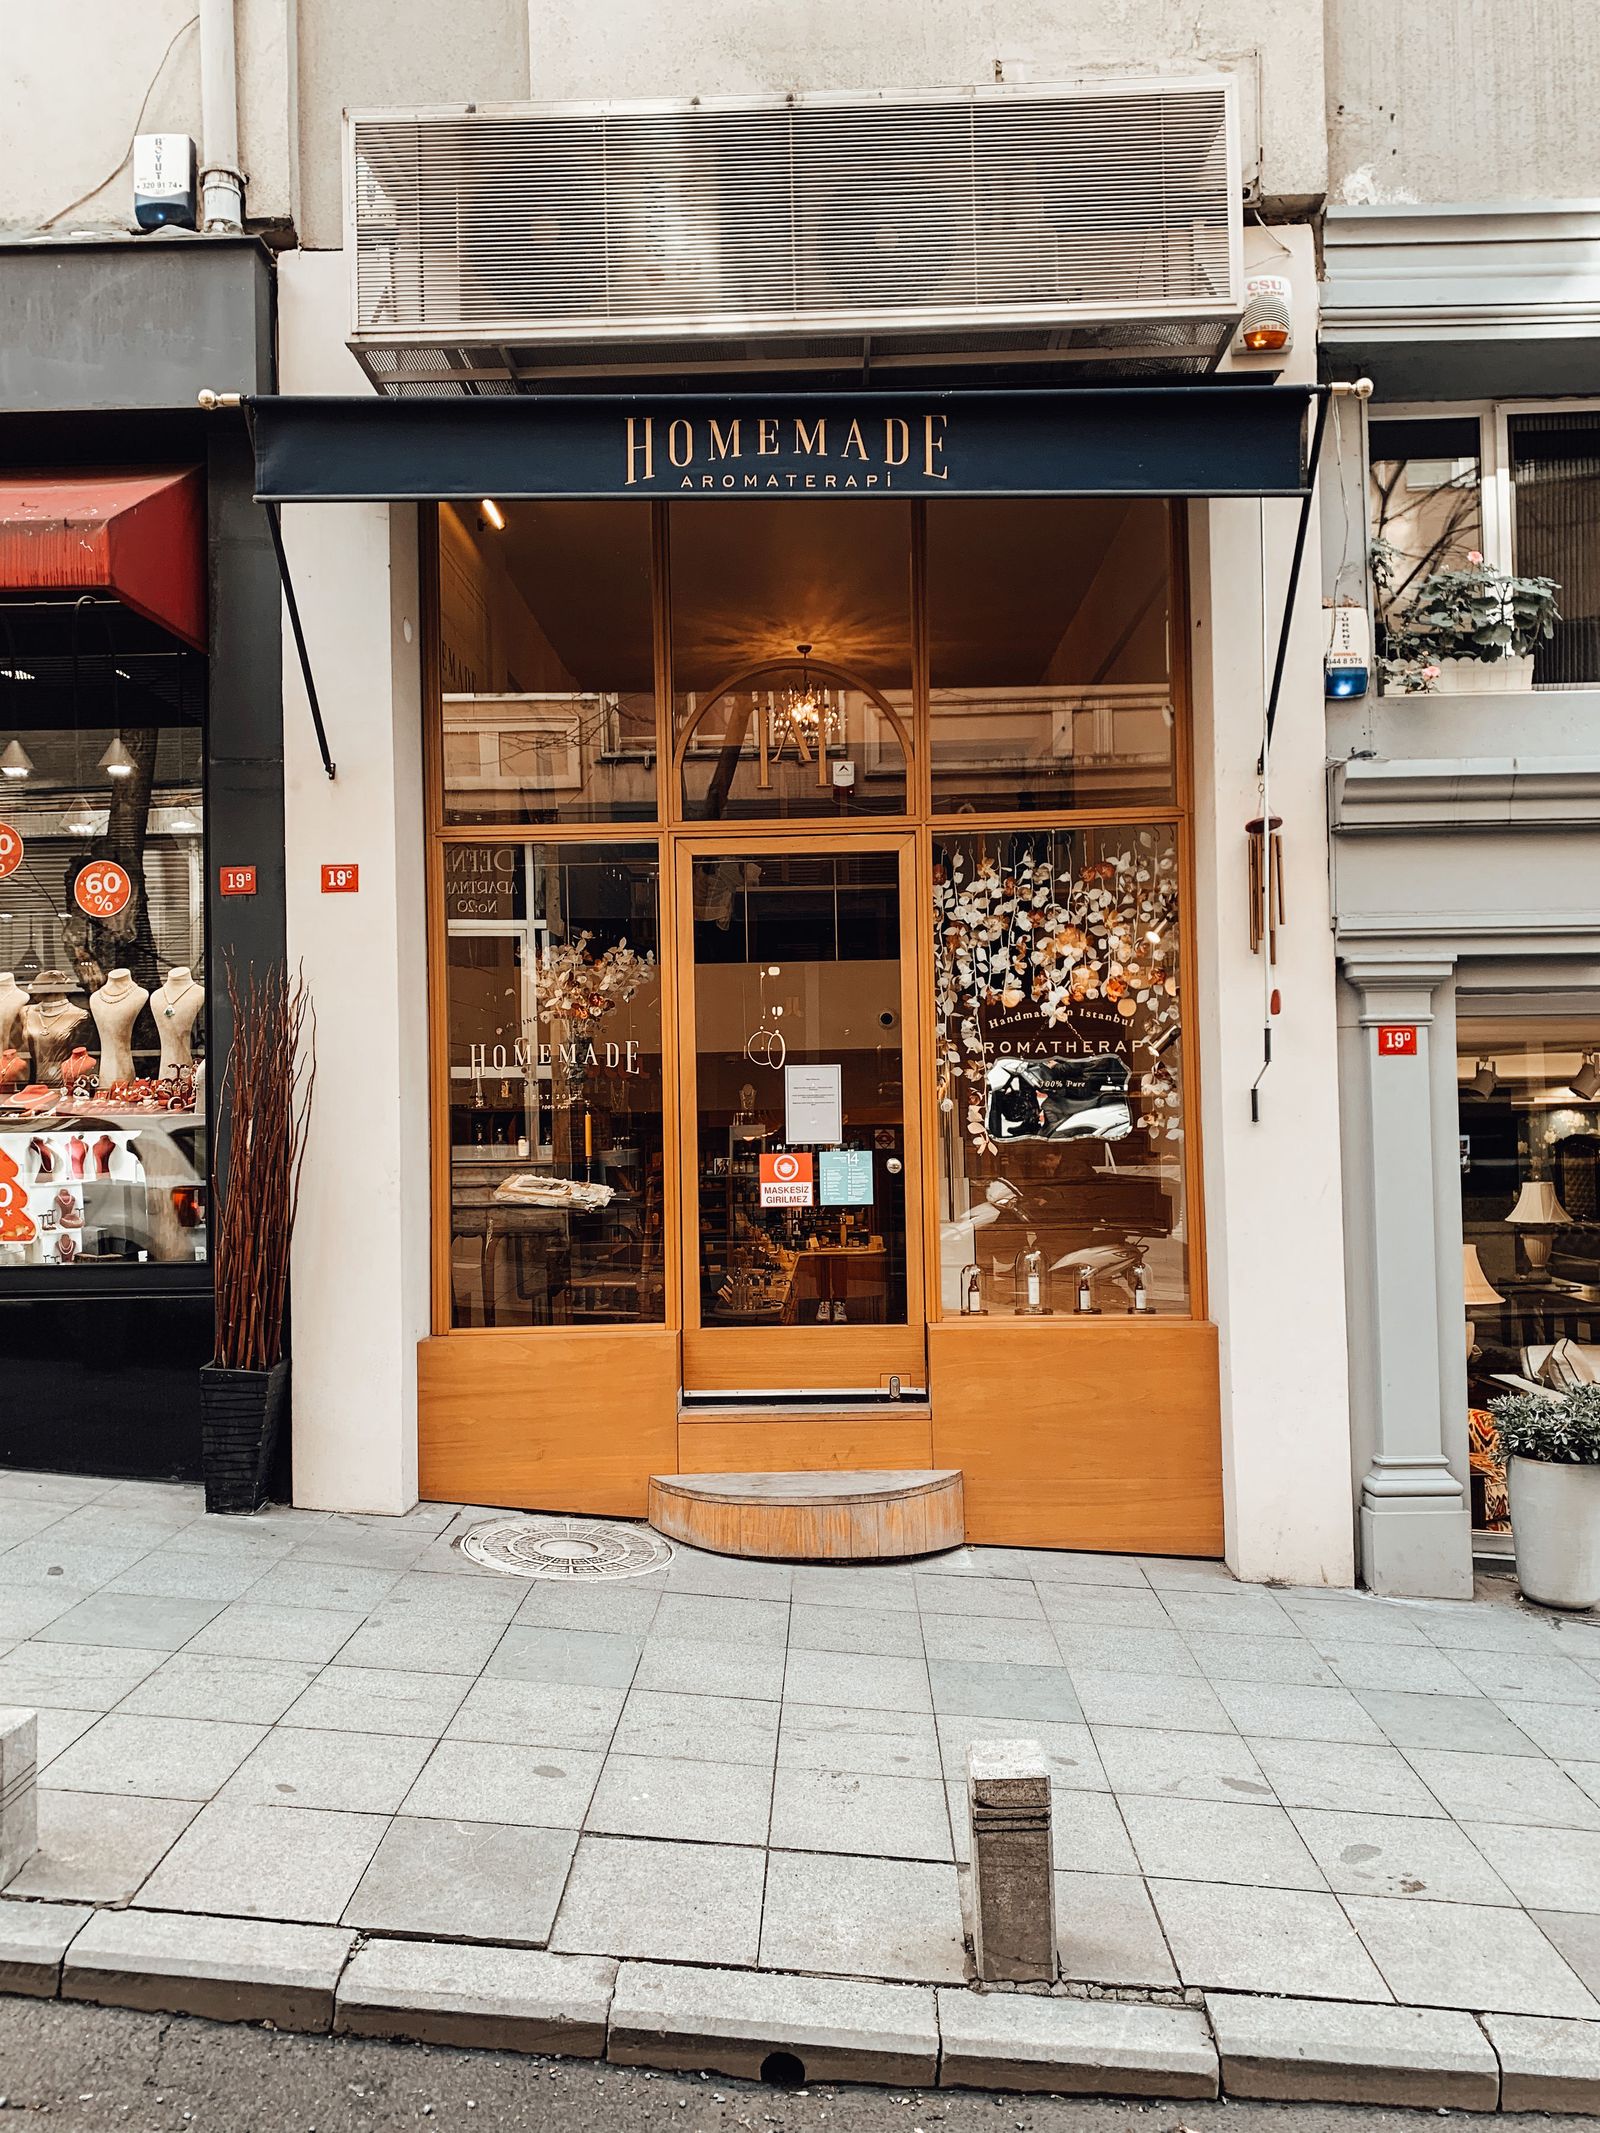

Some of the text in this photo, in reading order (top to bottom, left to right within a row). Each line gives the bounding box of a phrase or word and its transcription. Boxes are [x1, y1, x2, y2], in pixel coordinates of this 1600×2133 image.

[624, 416, 948, 485] HOMEMADE
[85, 872, 121, 894] 60
[94, 895, 113, 912] %
[469, 1040, 640, 1080] HOMEMADE
[846, 1153, 859, 1165] 14
